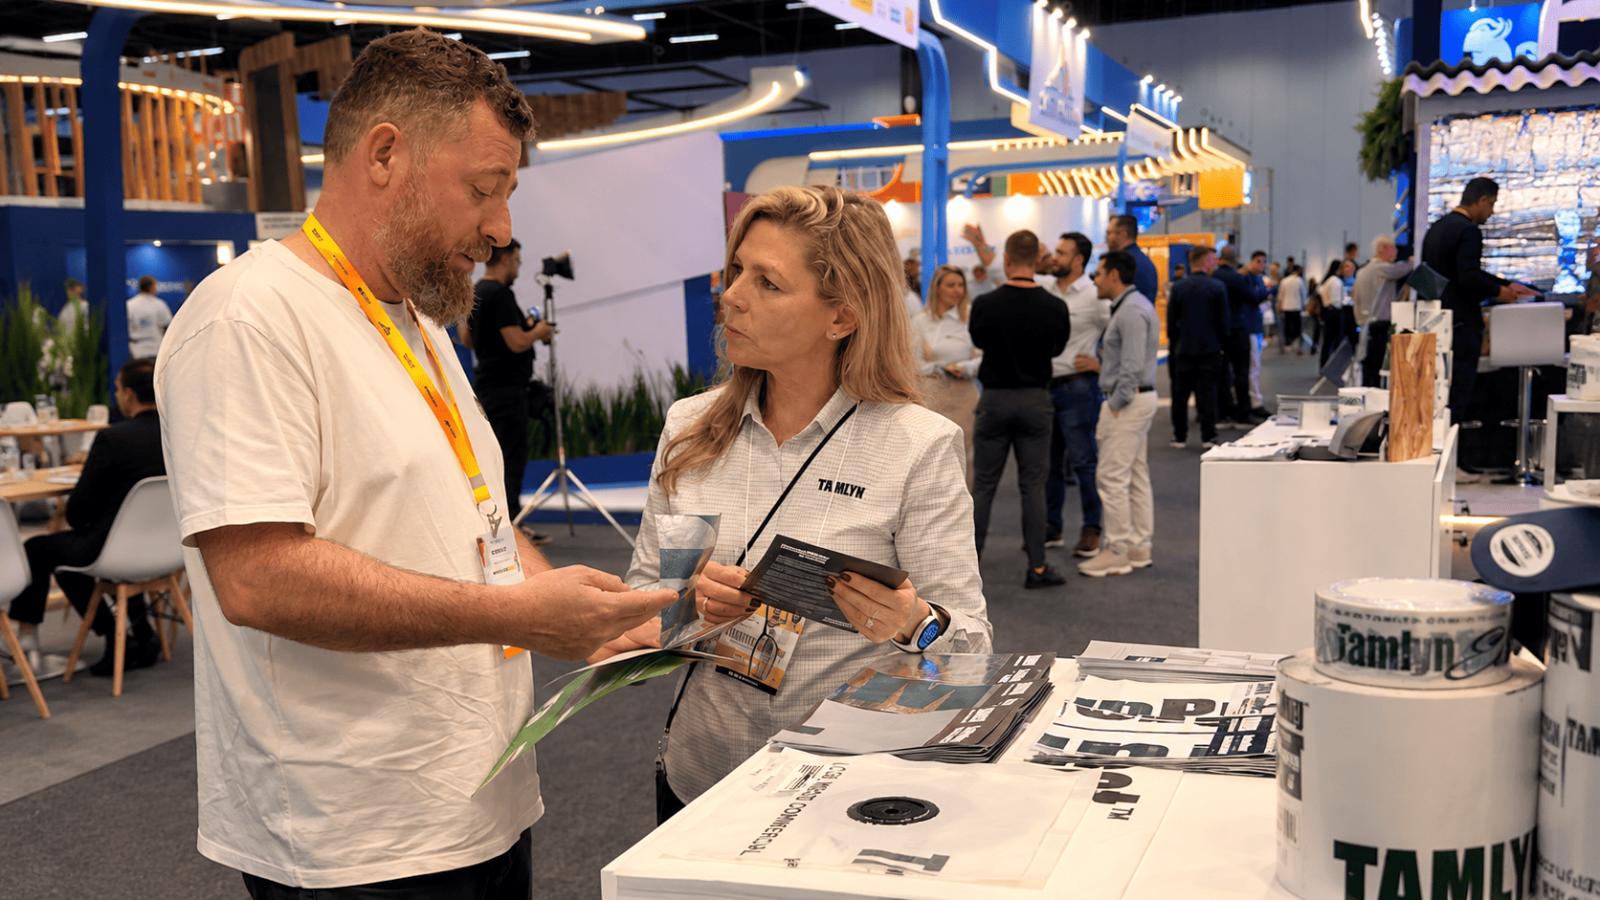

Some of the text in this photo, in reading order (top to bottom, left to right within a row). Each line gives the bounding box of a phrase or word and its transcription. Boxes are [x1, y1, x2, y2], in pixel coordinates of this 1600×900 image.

[818, 478, 866, 499] TAMLYN
[1336, 622, 1455, 676] Tamlyn
[1333, 826, 1538, 900] TAMLY
